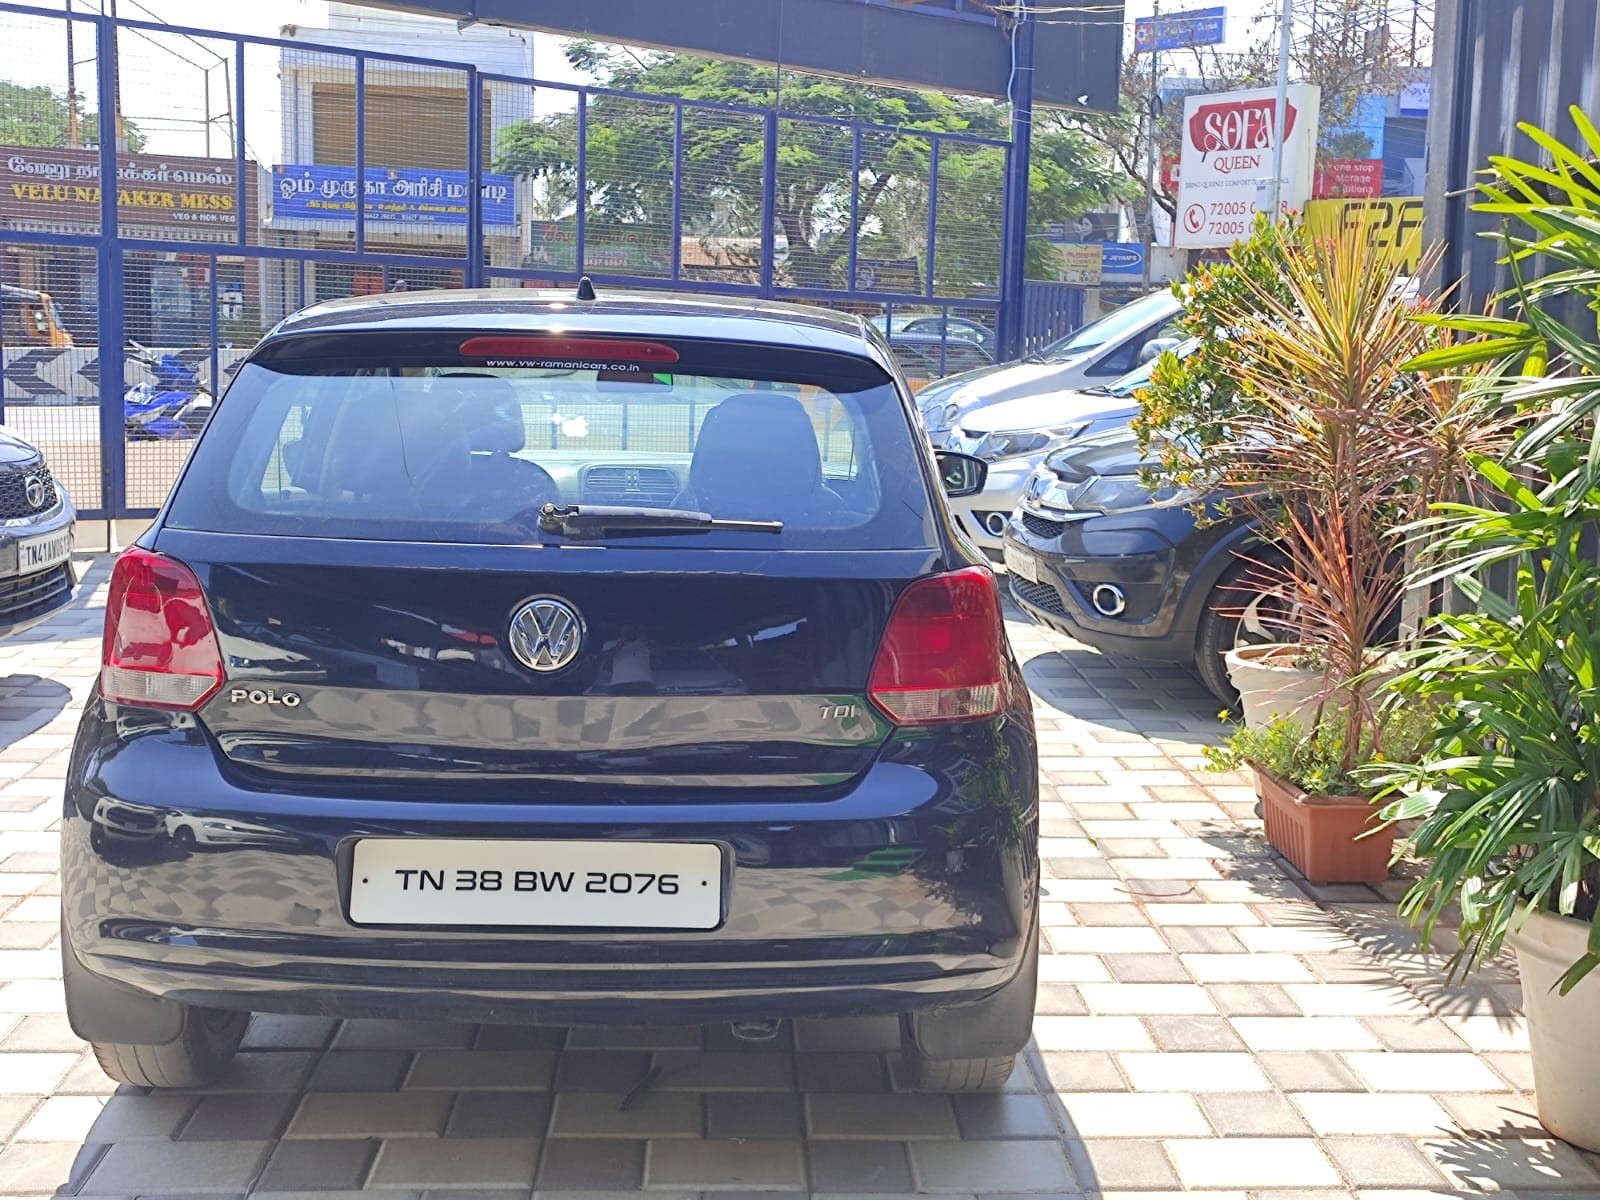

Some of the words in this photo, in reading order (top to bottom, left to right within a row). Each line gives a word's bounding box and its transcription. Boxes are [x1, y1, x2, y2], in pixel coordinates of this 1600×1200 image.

[1204, 107, 1275, 152] SOFA
[1213, 155, 1262, 174] QUEEN
[1354, 163, 1374, 173] stop
[280, 171, 315, 200] ஓம்
[12, 183, 68, 202] VELU
[181, 192, 233, 210] MESS
[173, 212, 190, 220] VEG
[1209, 201, 1246, 216] 72005
[1208, 221, 1245, 236] 72005
[486, 358, 640, 372] www.vw-ramanicars.co.in
[231, 689, 300, 707] POLO
[820, 704, 857, 720] TDI
[395, 869, 445, 891] TN
[455, 869, 503, 891] 38
[513, 871, 575, 893] BW
[585, 872, 680, 895] 2076
